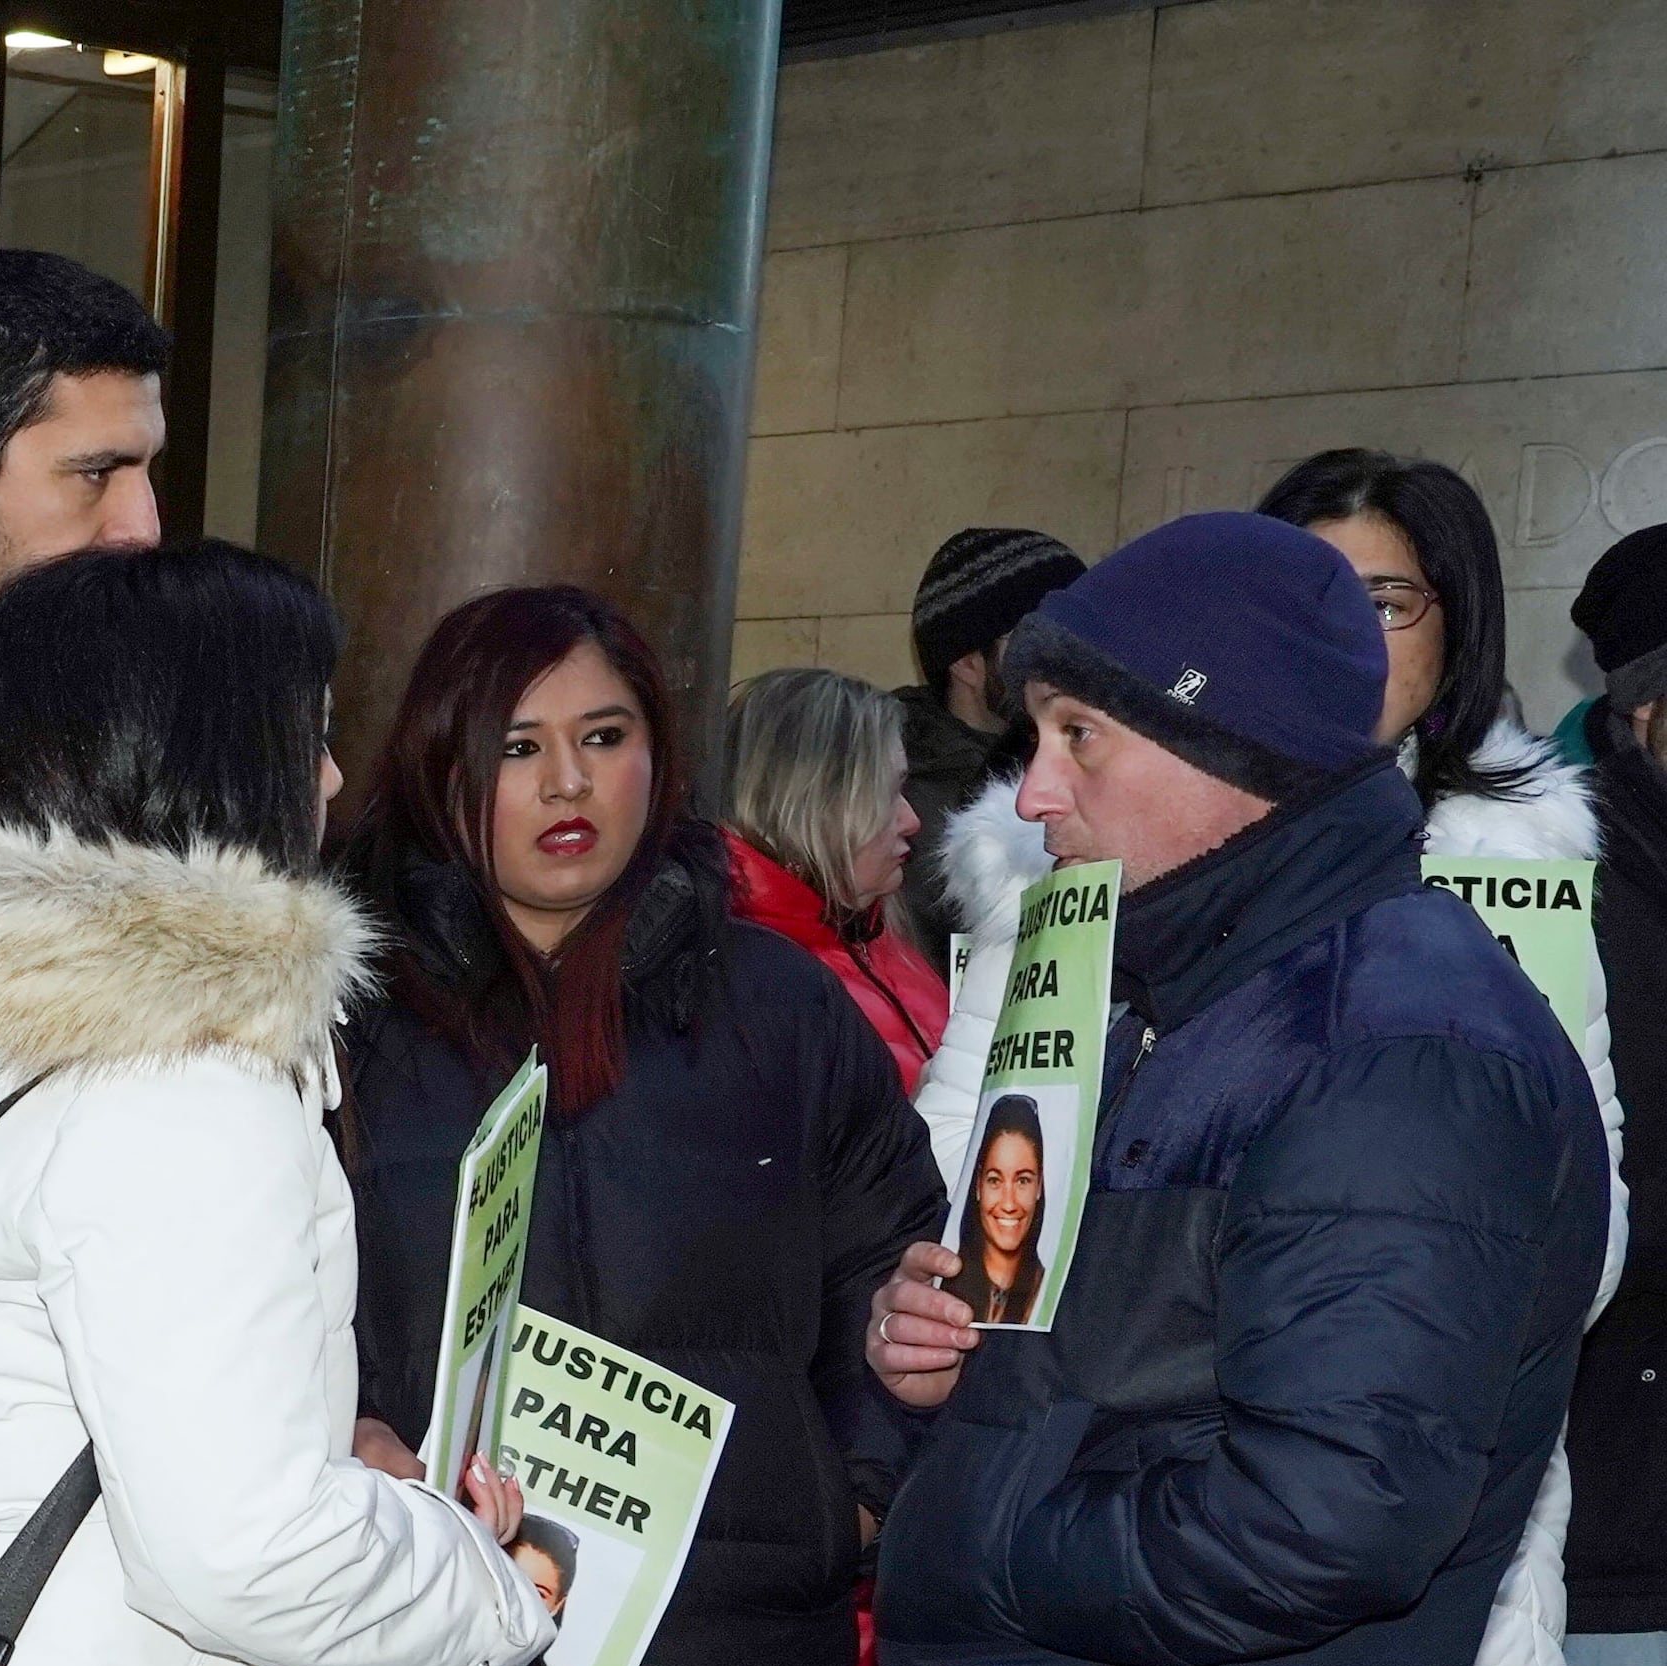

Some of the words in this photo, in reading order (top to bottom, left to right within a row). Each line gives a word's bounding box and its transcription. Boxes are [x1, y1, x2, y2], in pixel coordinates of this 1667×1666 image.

[1008, 959, 1059, 1008] PARA
[986, 1029, 1075, 1077] ESTHER
[468, 1093, 541, 1218] #JUSTICIA
[483, 1185, 520, 1267] PARA
[509, 1386, 637, 1467] PARA
